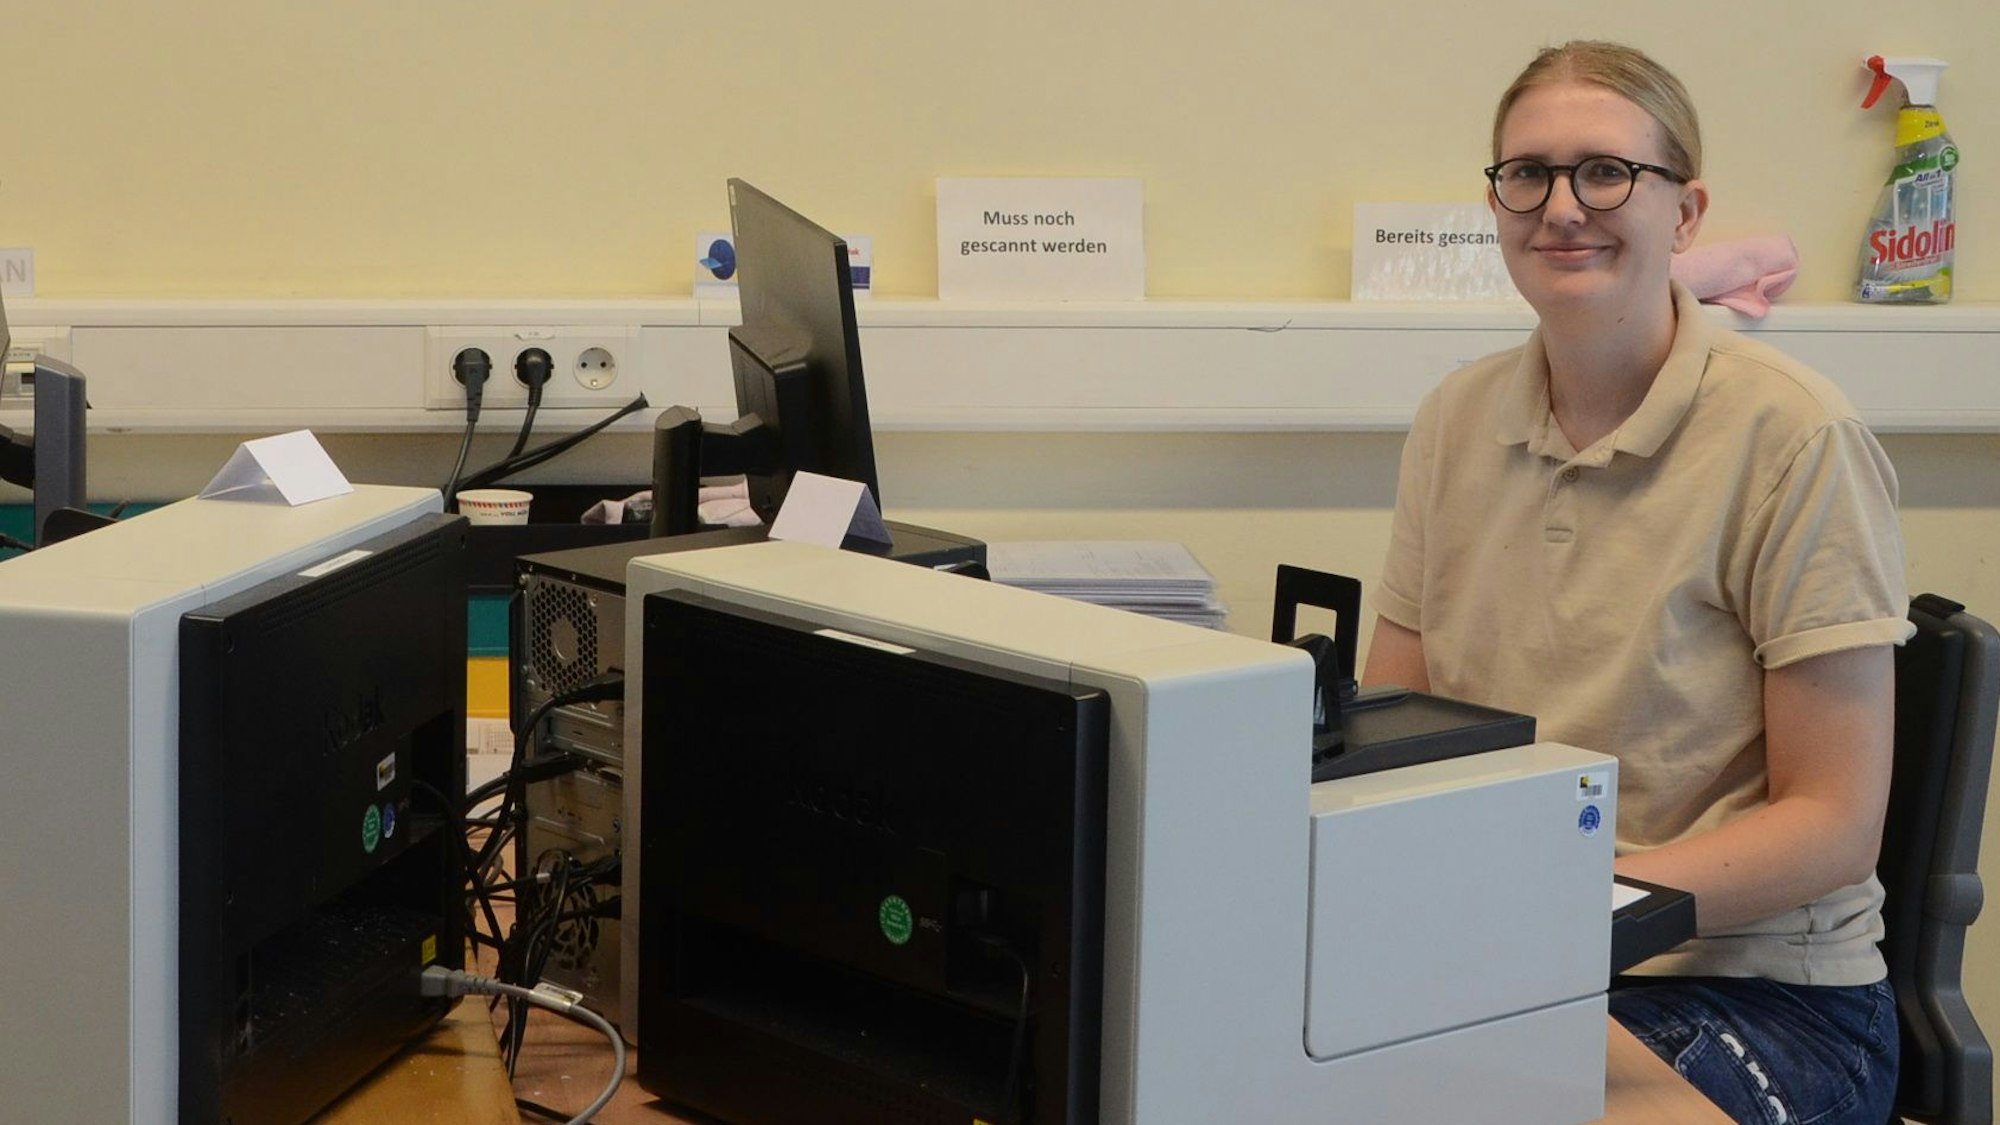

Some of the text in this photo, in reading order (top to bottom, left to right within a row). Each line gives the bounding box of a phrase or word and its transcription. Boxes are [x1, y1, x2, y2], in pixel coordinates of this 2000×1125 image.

[983, 211, 1075, 226] Muss noch
[1375, 228, 1435, 244] Bereits
[1870, 220, 1955, 264] Sidolin
[960, 238, 1107, 256] gescannt werden
